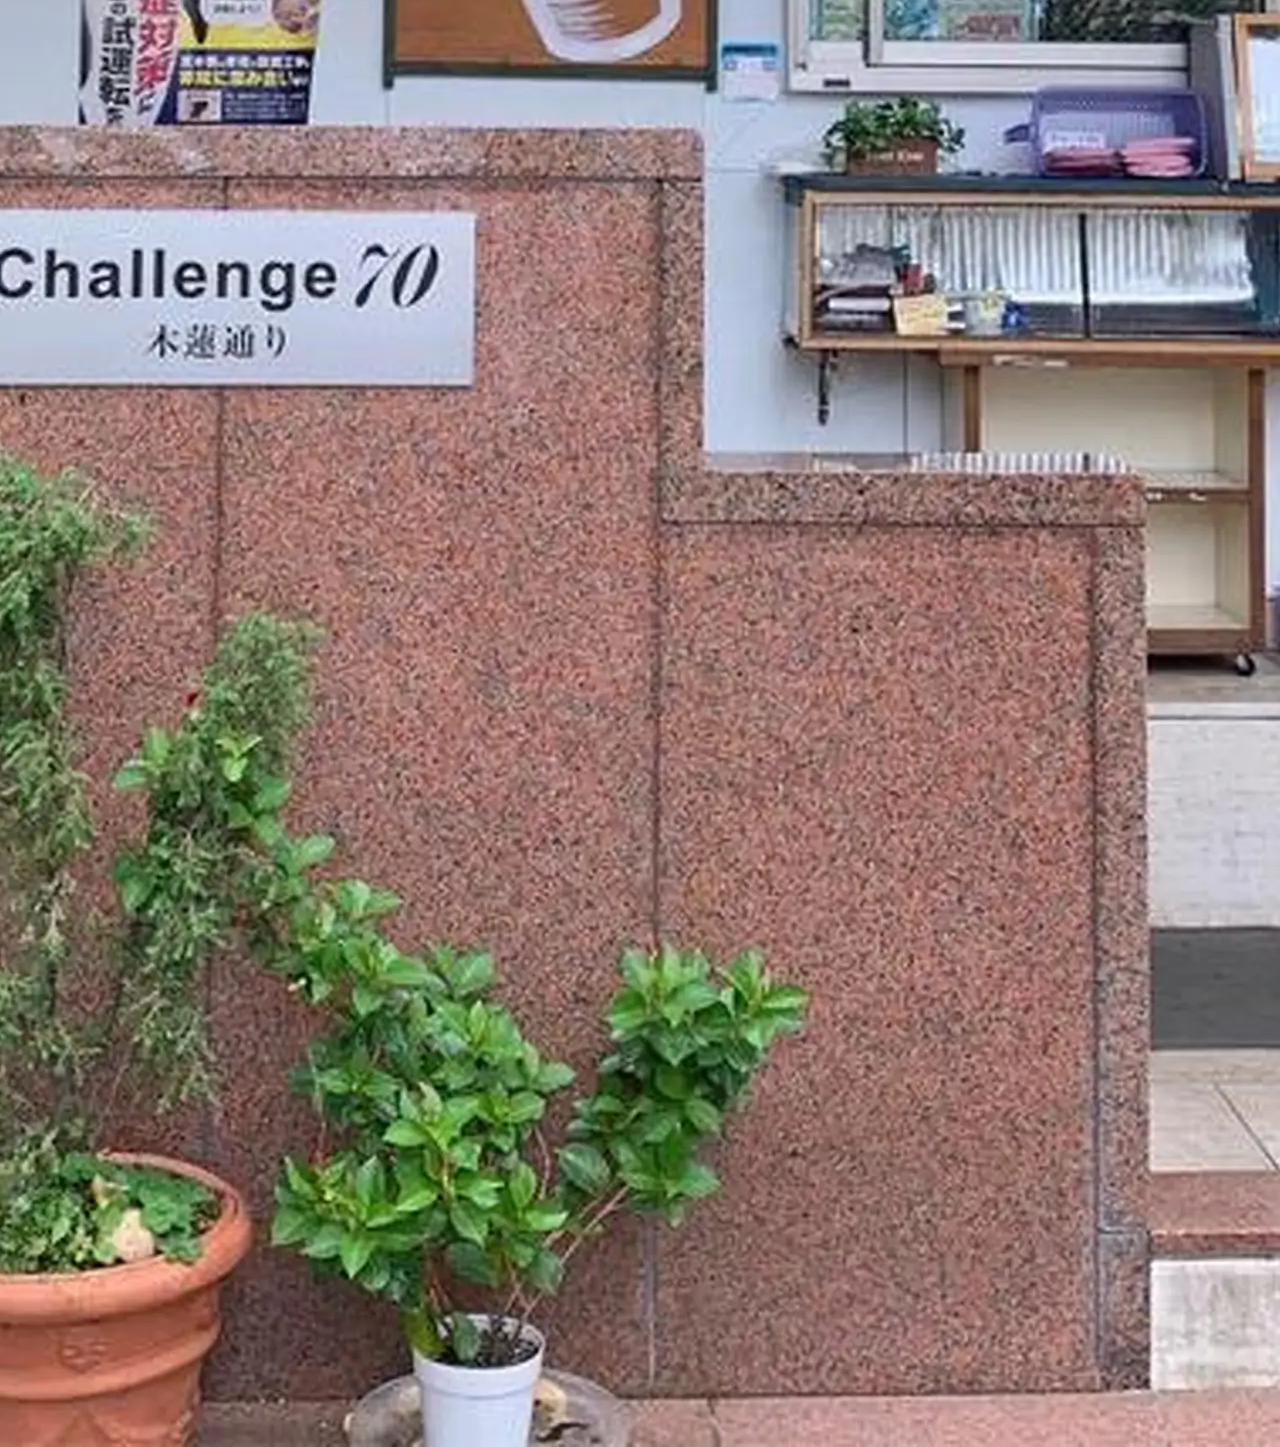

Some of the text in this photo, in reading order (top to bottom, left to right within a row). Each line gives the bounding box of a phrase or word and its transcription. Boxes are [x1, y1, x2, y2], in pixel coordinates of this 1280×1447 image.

[354, 243, 440, 308] 70
[147, 324, 287, 360] 木蓮通り
